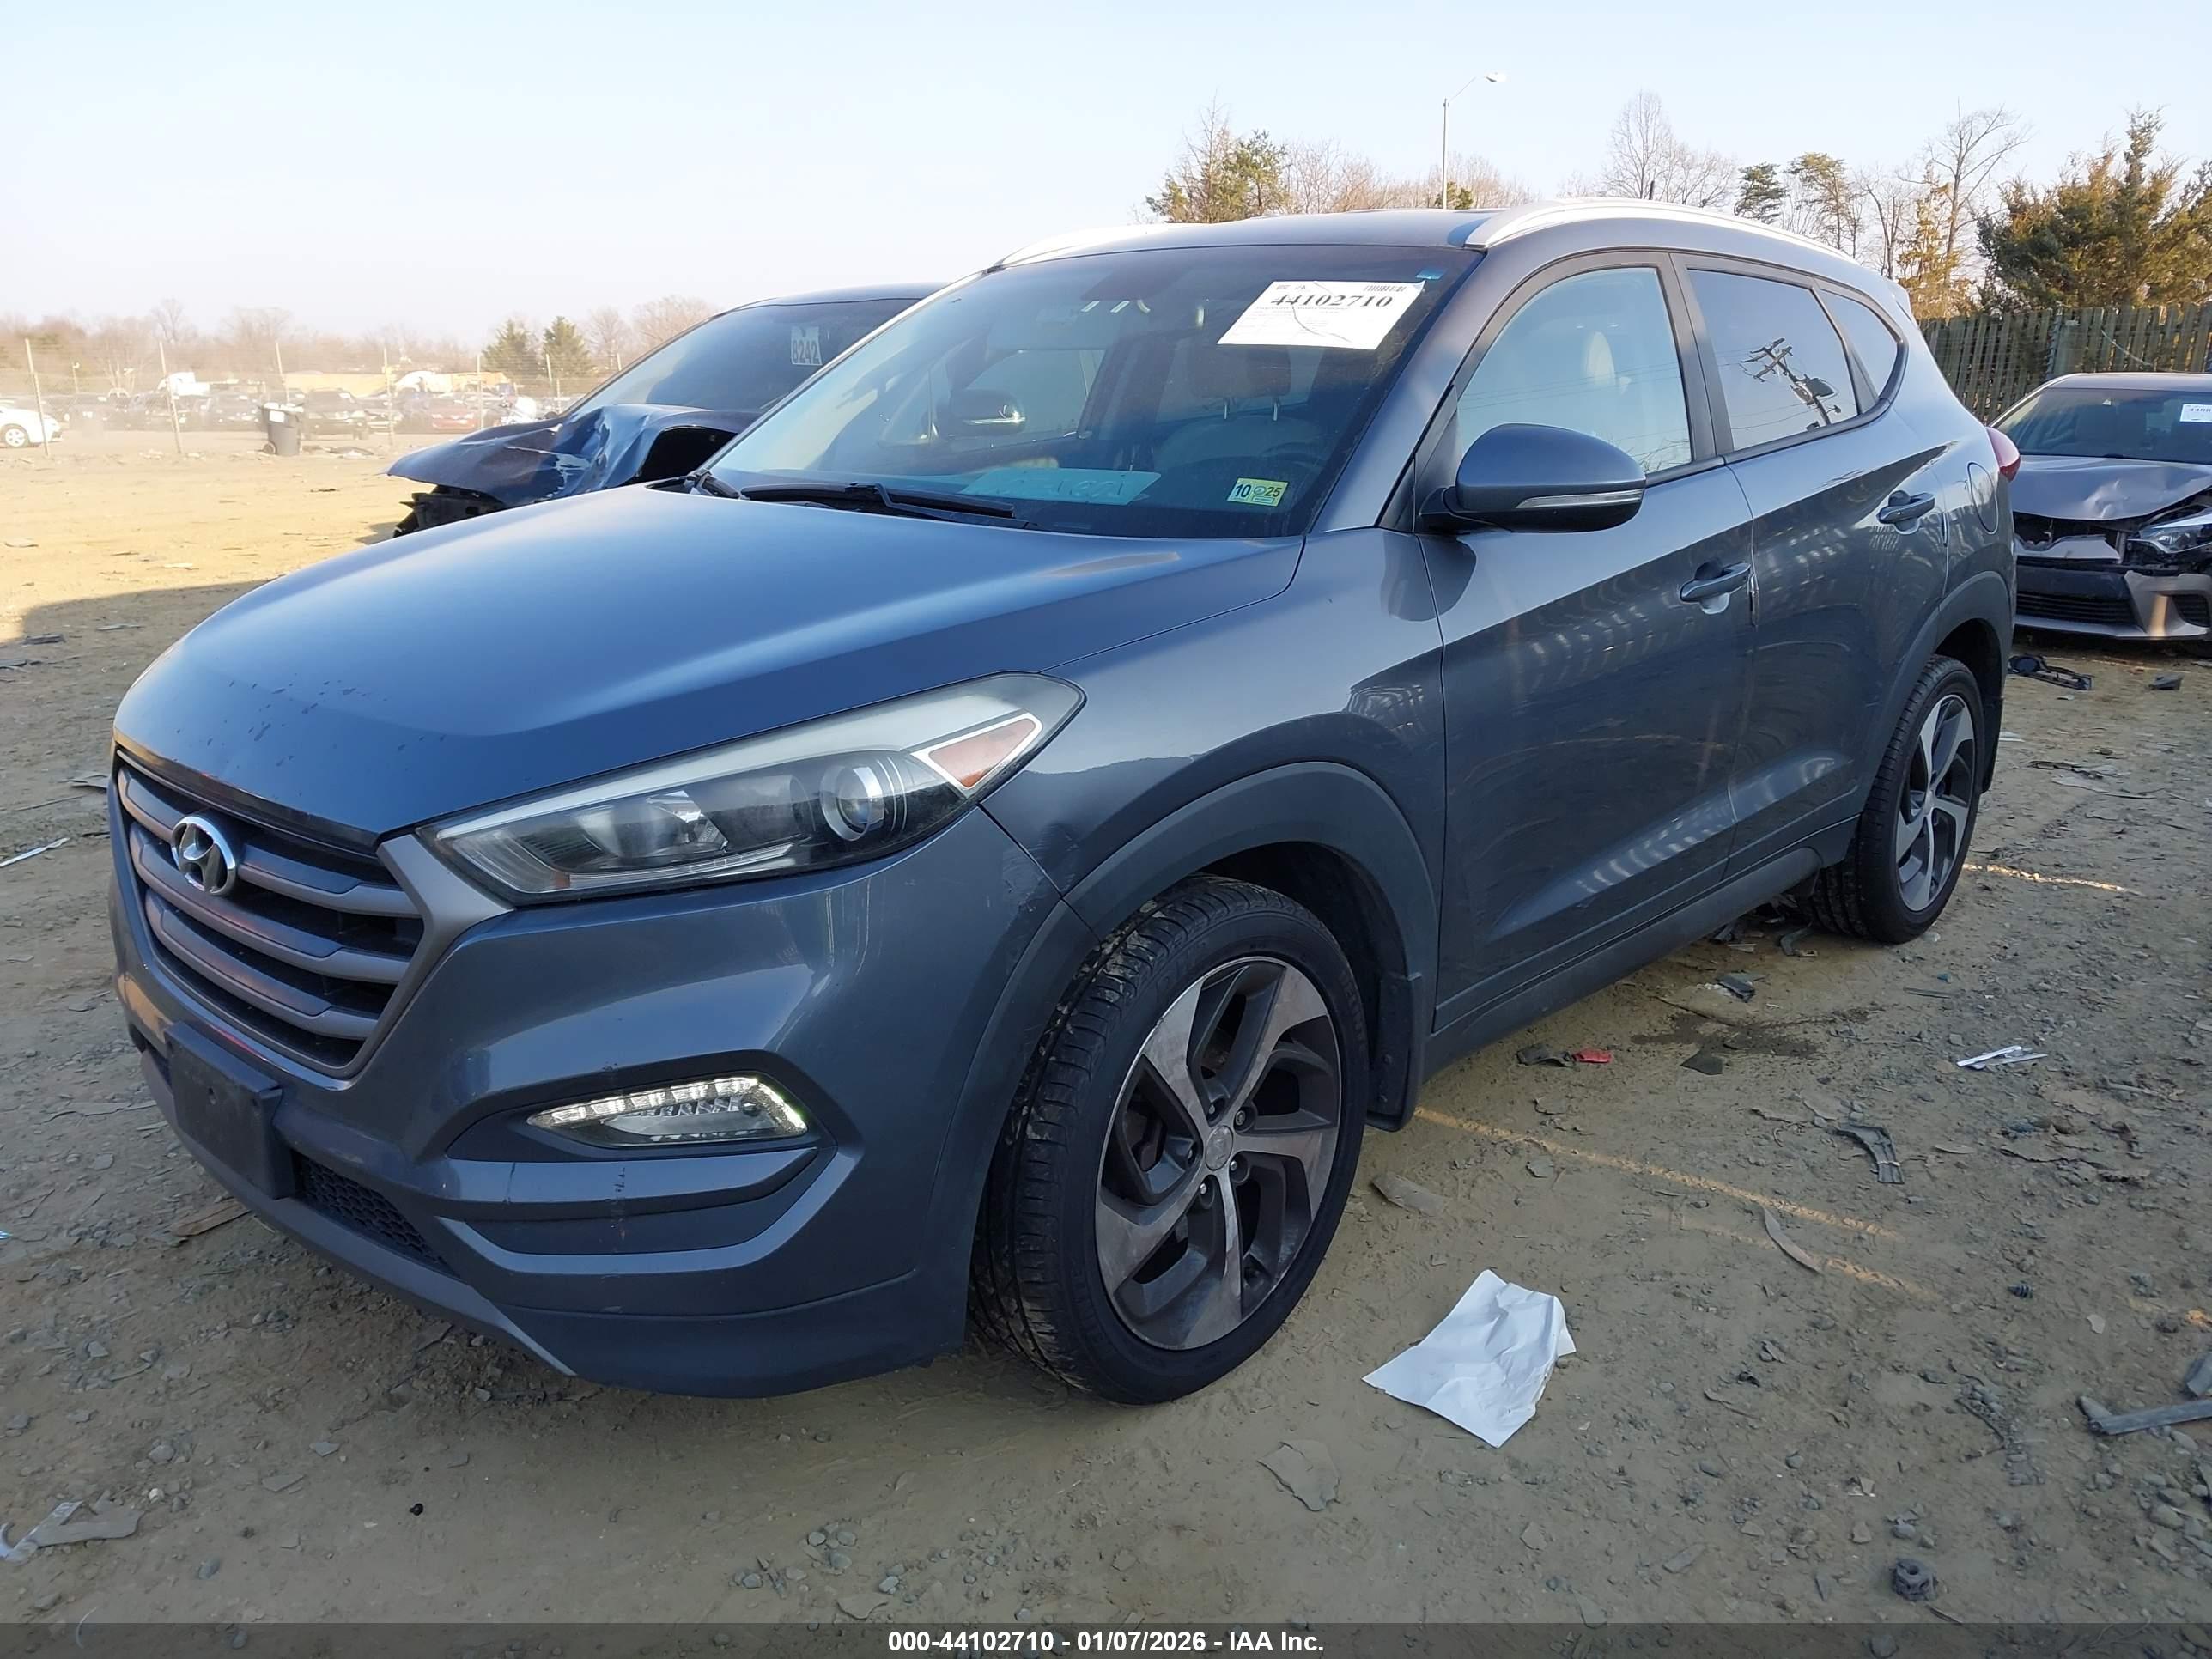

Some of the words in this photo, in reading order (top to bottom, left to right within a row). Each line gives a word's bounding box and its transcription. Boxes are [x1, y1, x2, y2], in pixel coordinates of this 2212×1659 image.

[1271, 295, 1393, 307] 44102710
[1236, 484, 1252, 498] 10
[1264, 486, 1282, 498] 25
